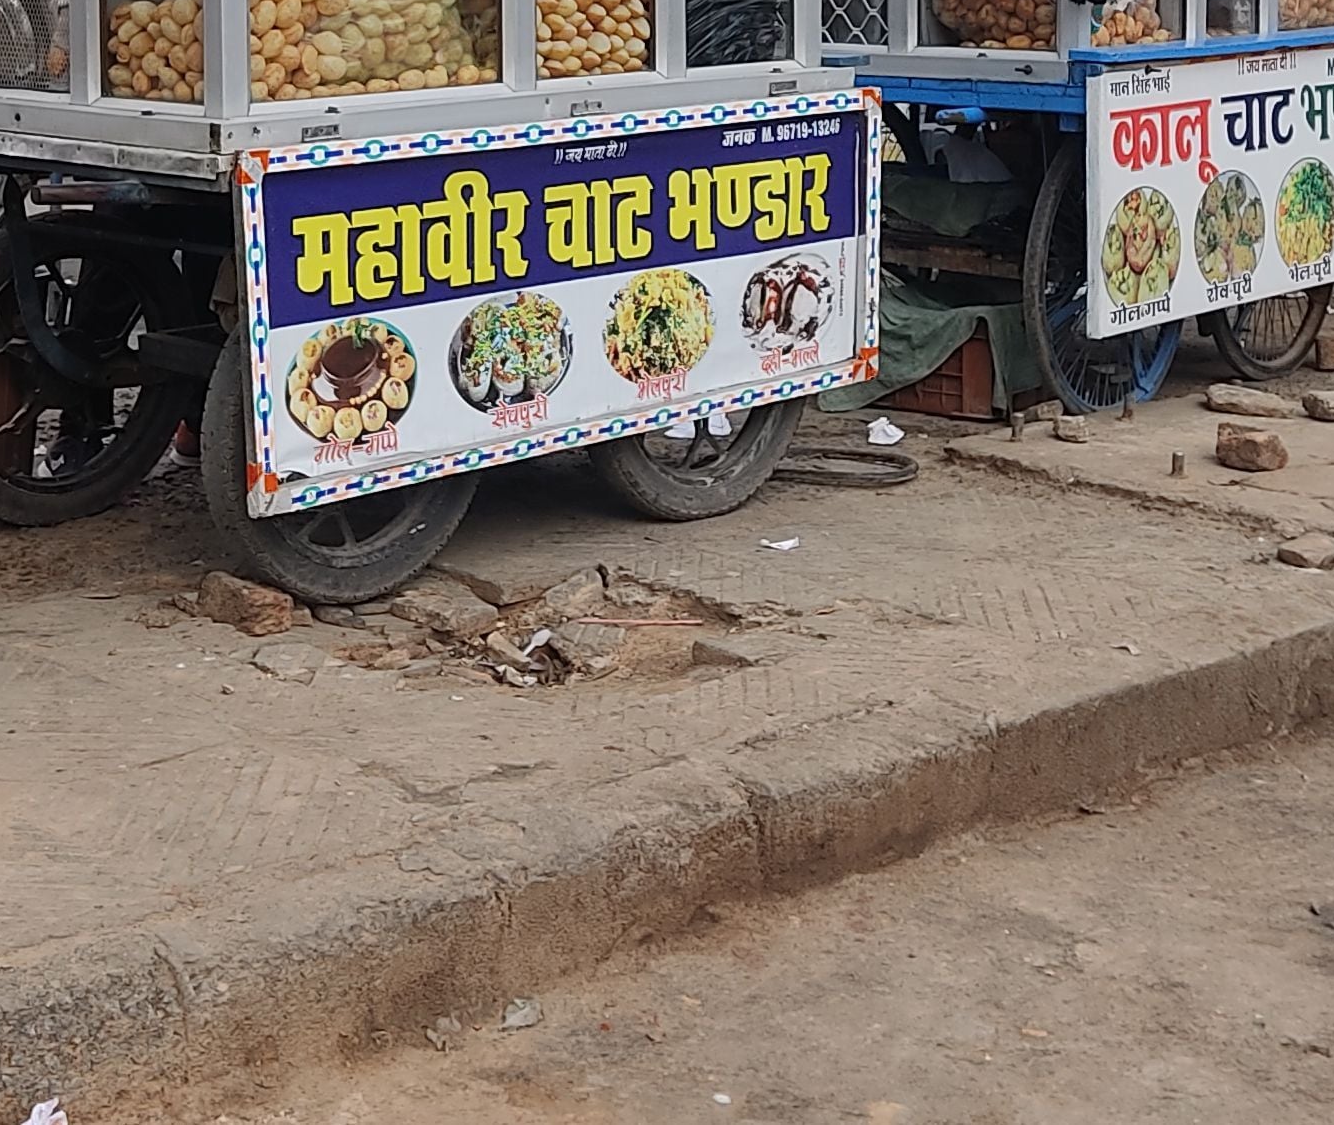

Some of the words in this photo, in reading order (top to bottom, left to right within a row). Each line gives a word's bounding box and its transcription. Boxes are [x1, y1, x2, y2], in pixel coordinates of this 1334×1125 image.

[722, 128, 756, 148] जनक
[777, 118, 840, 142] 96719-13246
[1109, 99, 1219, 184] कालू
[1221, 88, 1295, 153] चाट
[292, 171, 531, 307] महावीर
[545, 175, 655, 268] चाट
[669, 153, 832, 251] भण्डार
